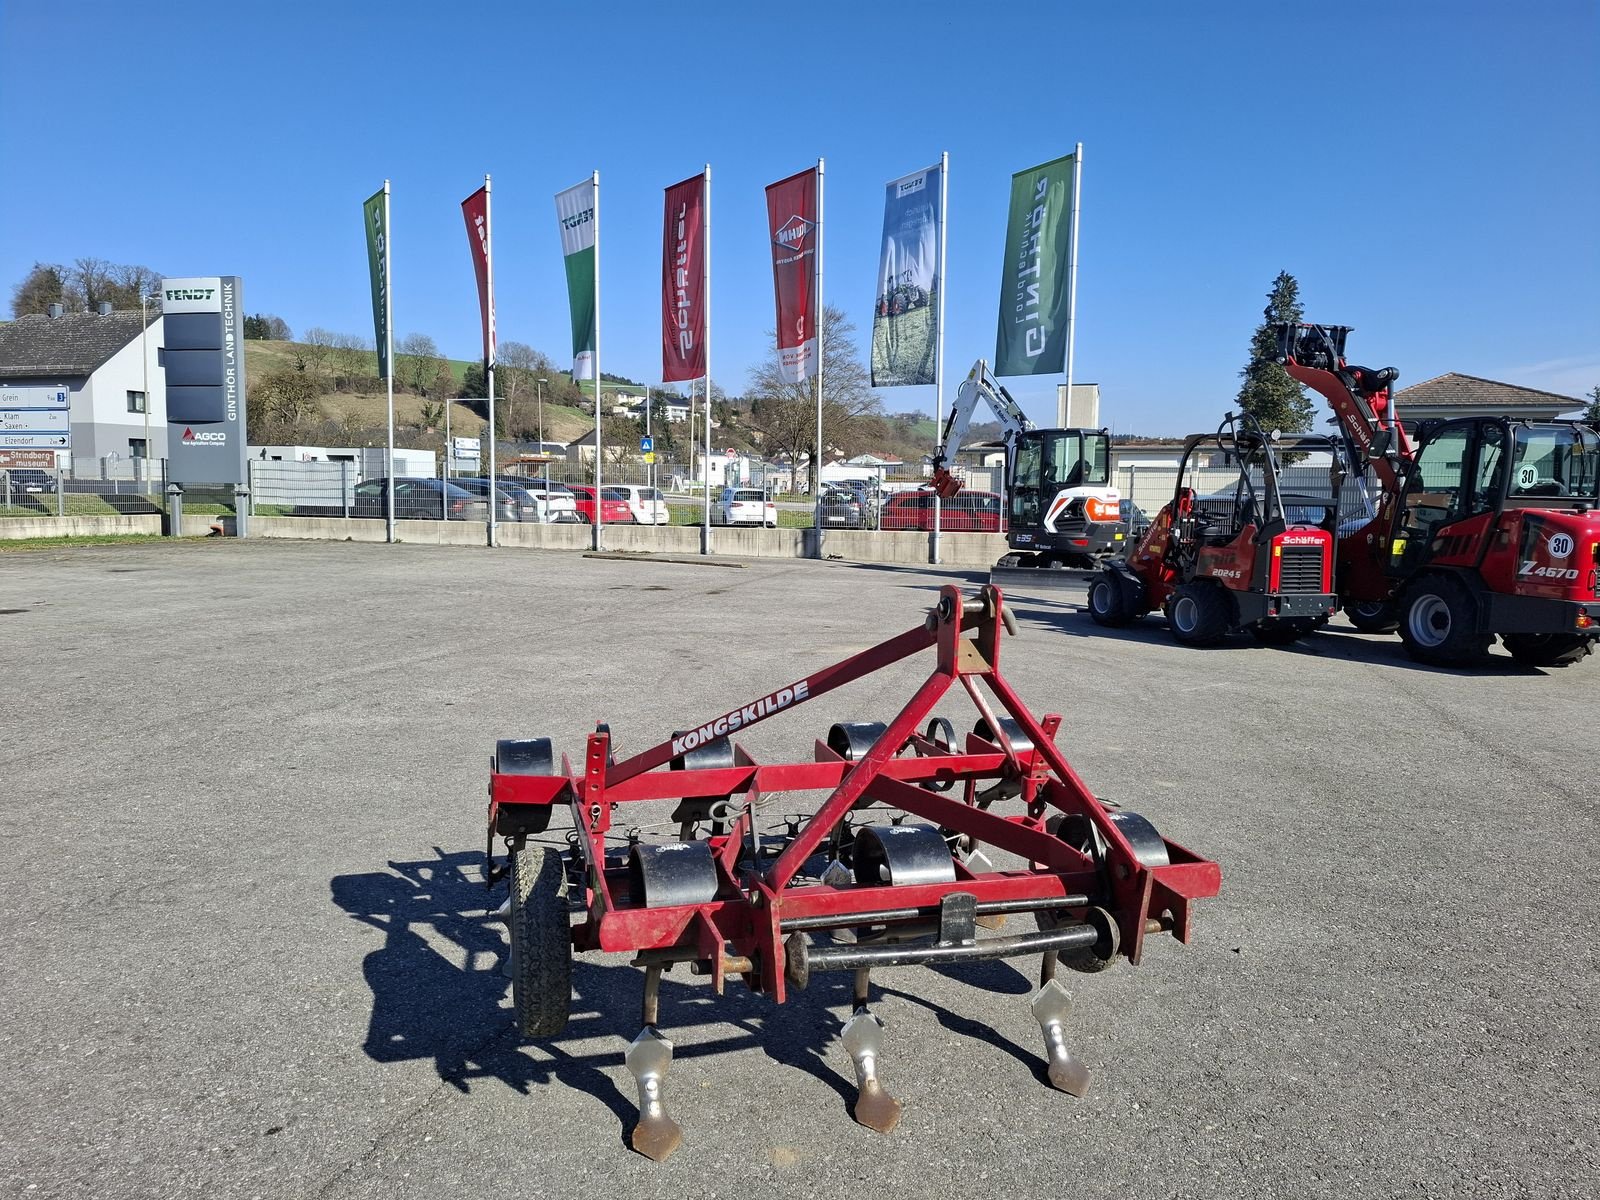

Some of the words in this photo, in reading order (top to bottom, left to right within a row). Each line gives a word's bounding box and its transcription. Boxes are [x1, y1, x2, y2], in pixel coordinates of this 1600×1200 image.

[166, 289, 215, 301] FENDT
[224, 283, 235, 365] LANDTECHNIK
[2, 393, 19, 402] Grein
[225, 368, 236, 421] GINTHÖR
[5, 422, 23, 430] Saxen
[1346, 414, 1371, 448] Schäff
[5, 437, 34, 445] Eizendorf
[194, 432, 226, 441] AGCO
[1522, 470, 1534, 483] 30
[1281, 536, 1325, 545] Schäffer
[1553, 537, 1568, 553] 30
[1519, 560, 1579, 579] Z4670
[672, 680, 809, 756] KONGSKILDE
